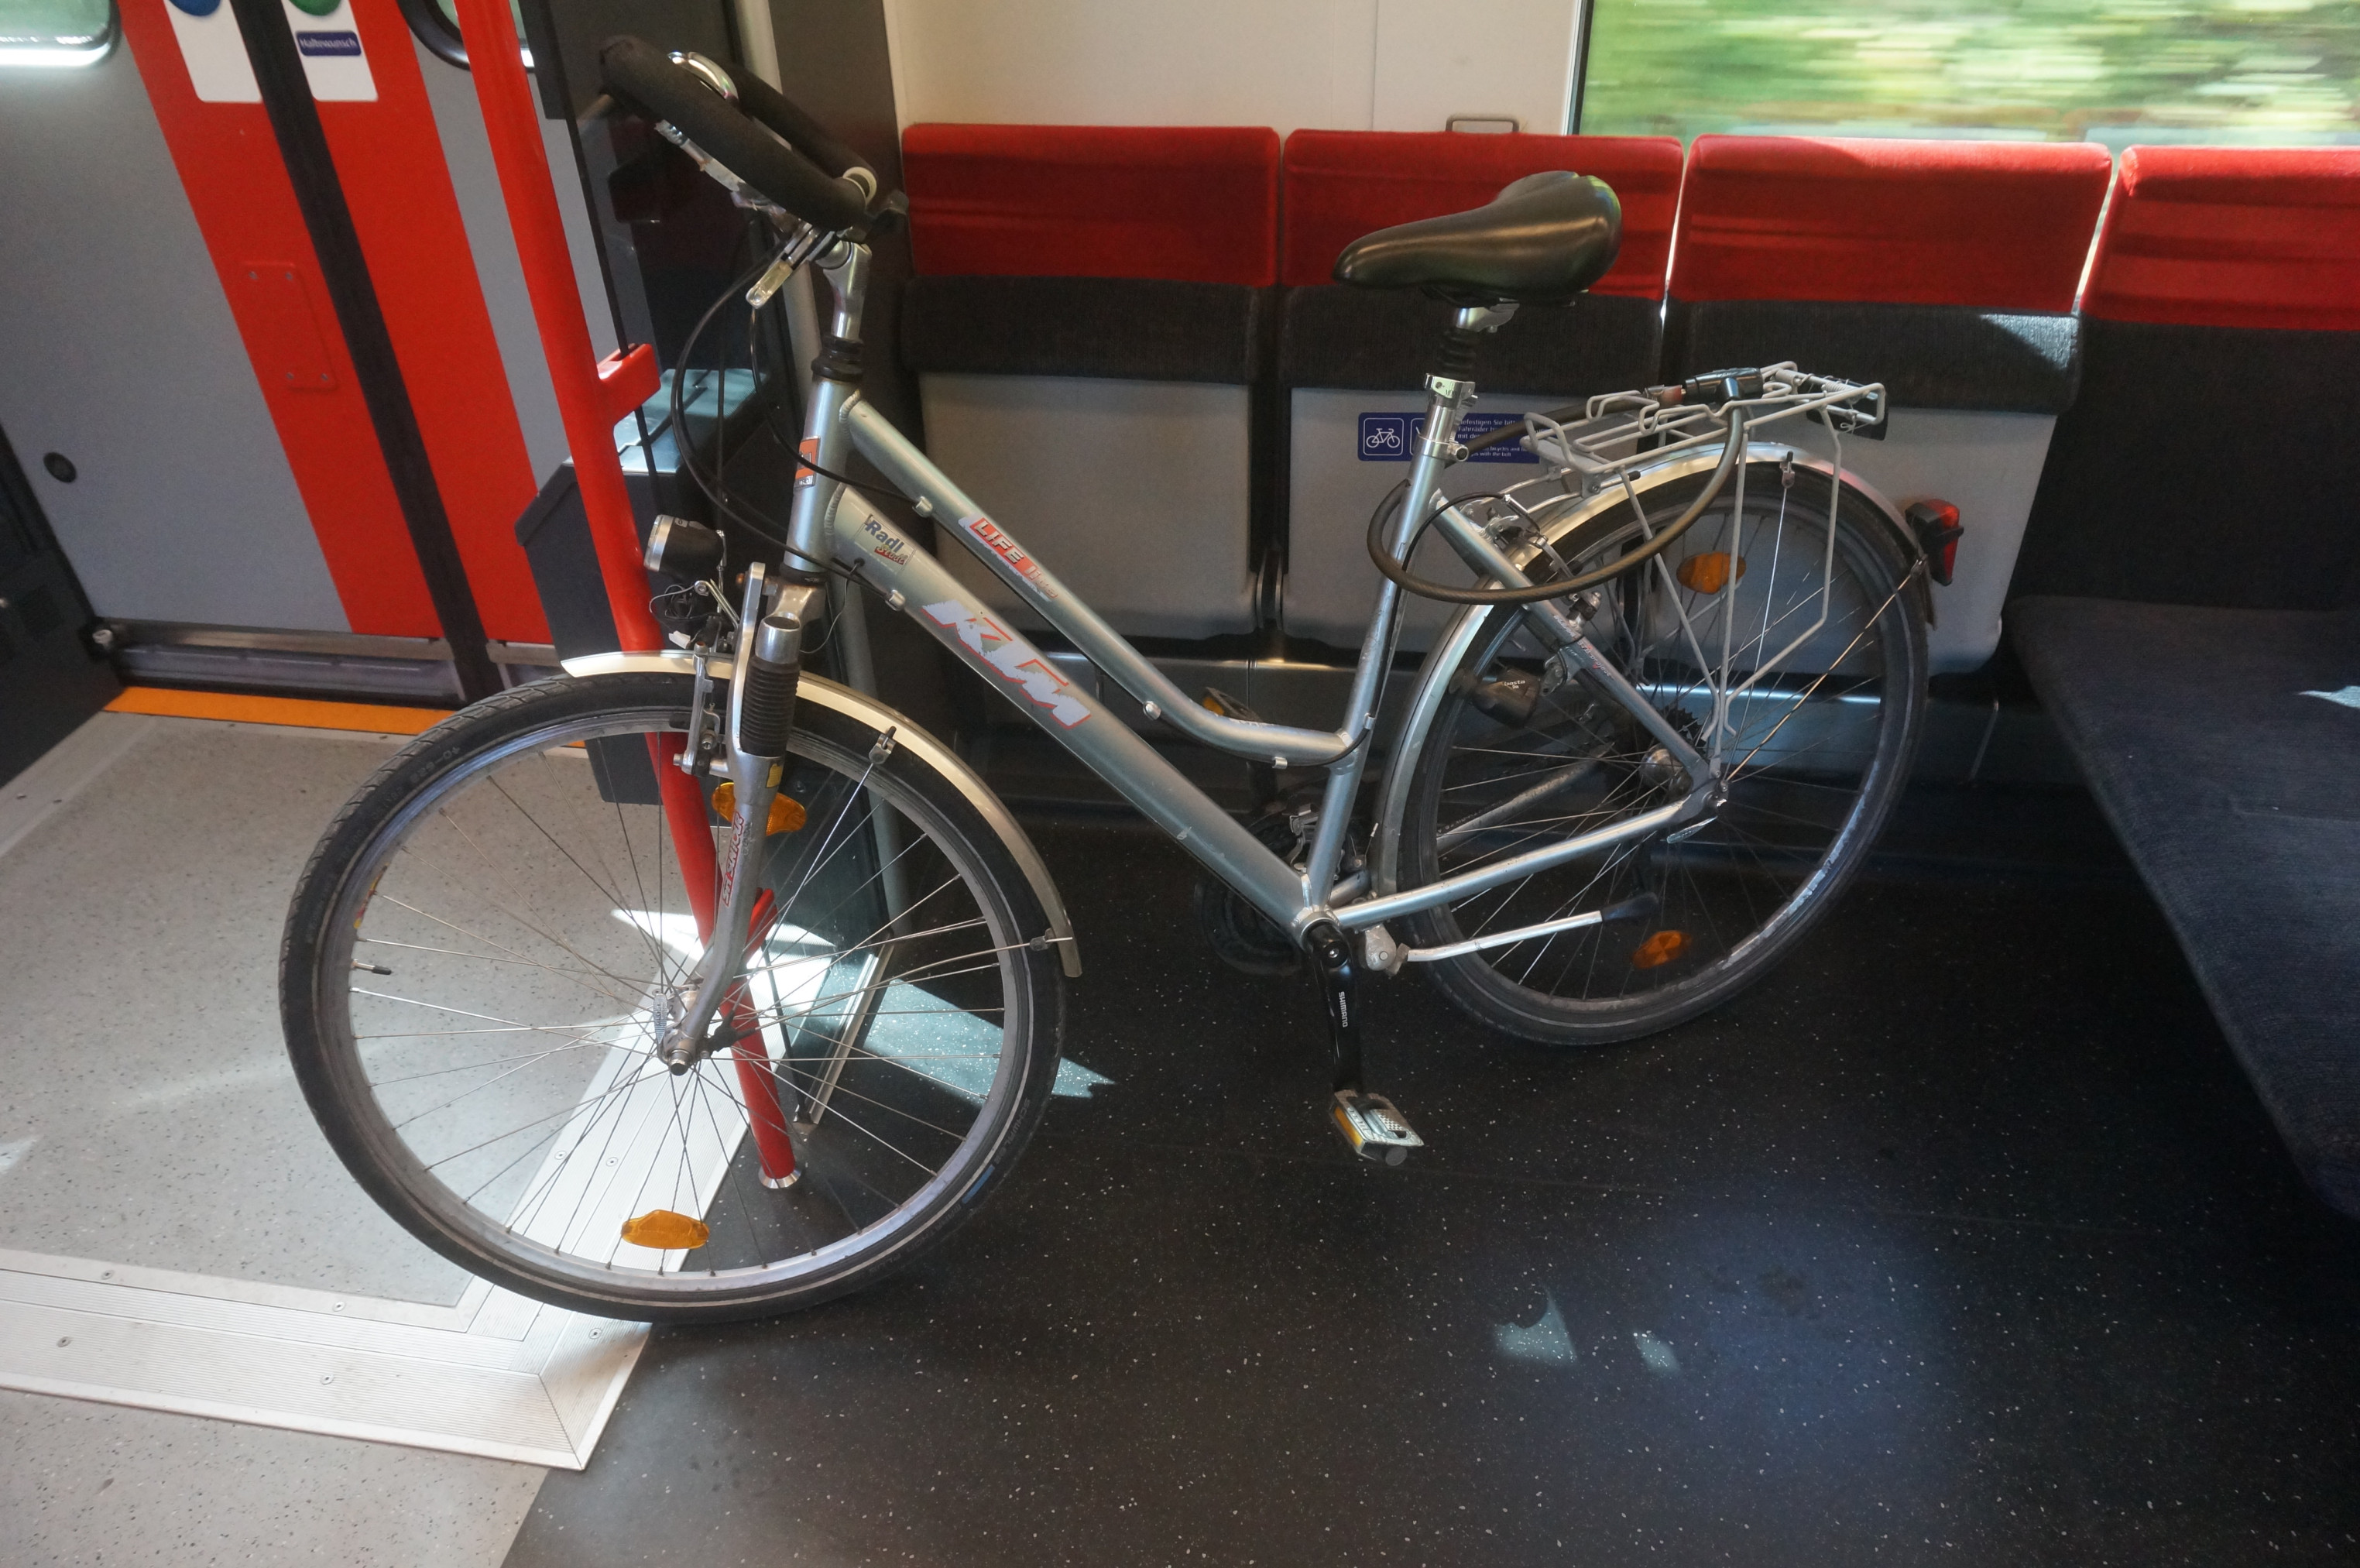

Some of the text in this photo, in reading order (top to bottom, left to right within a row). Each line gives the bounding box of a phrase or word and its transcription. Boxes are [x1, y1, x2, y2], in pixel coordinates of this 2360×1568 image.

[864, 520, 904, 553] Radl
[973, 520, 1024, 564] LIFE
[920, 599, 1092, 729] KTM
[1339, 991, 1348, 1028] SHIMANO
